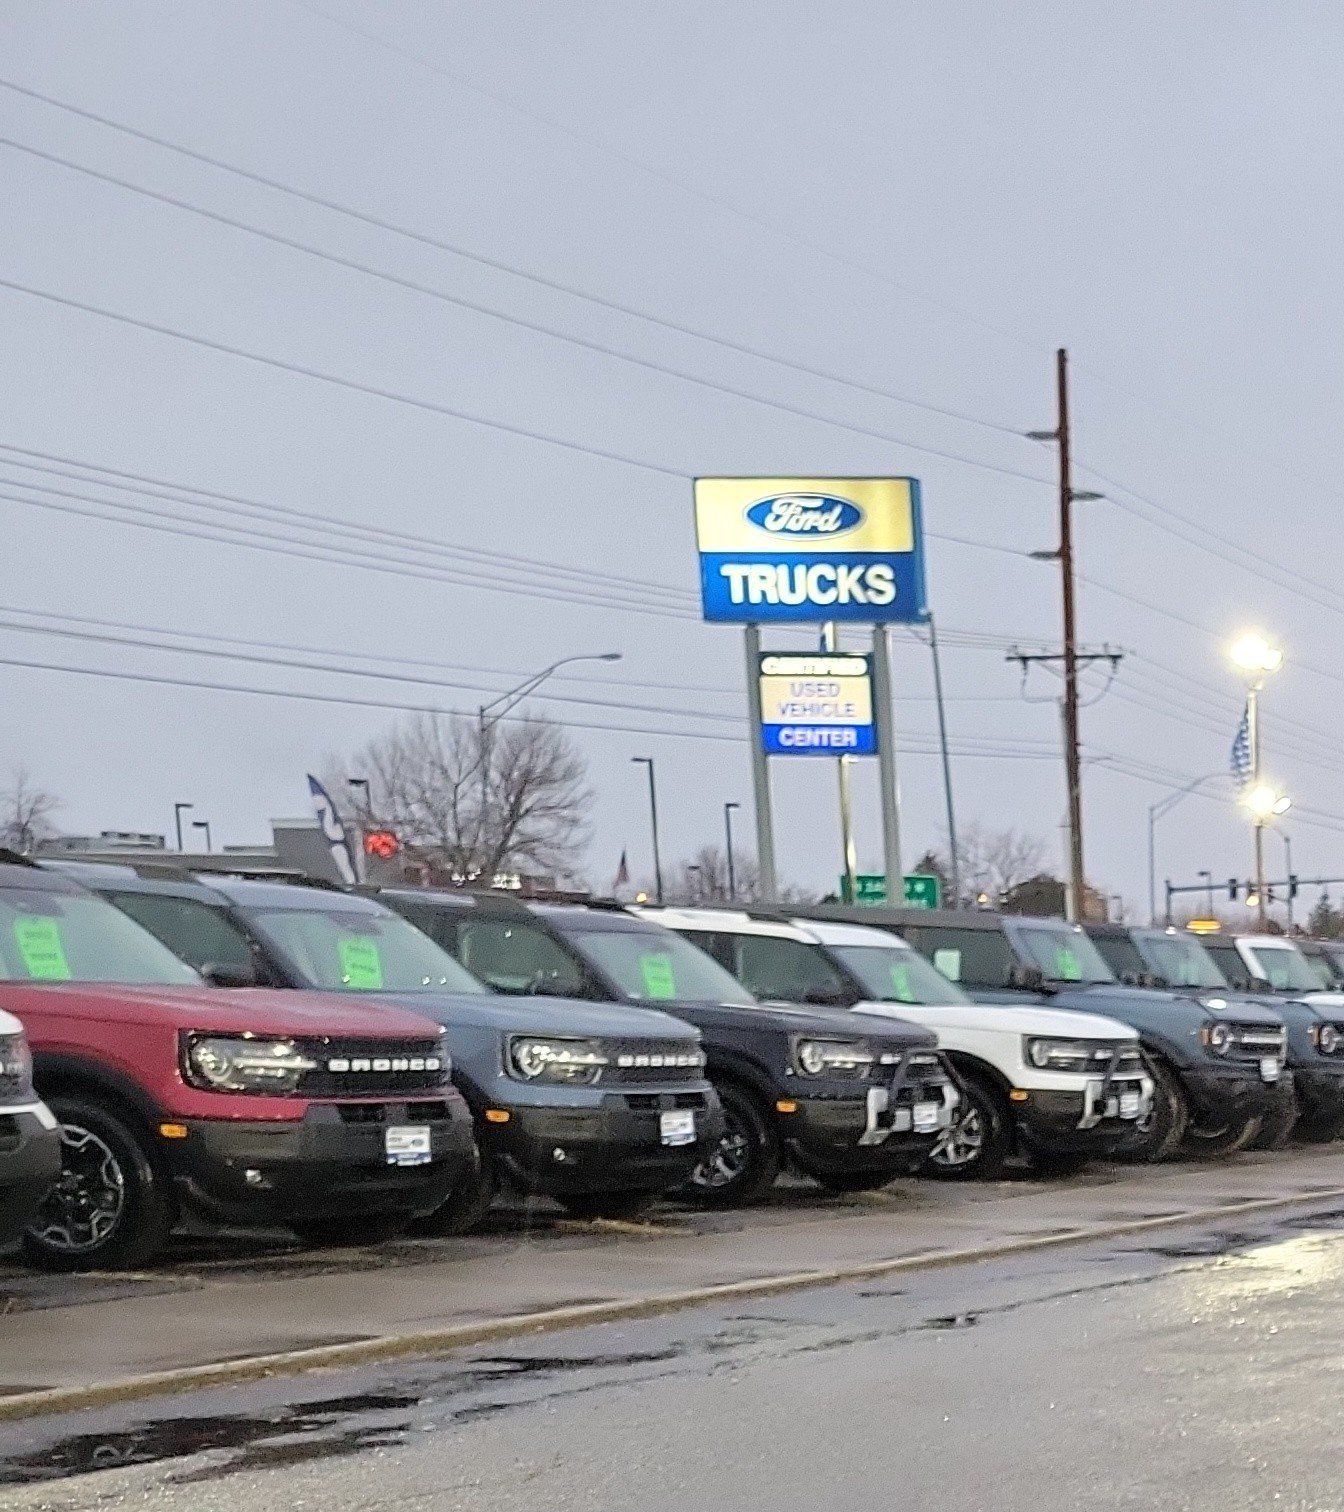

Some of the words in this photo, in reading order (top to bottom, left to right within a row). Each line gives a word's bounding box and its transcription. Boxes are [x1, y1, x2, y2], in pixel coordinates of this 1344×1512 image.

[764, 497, 843, 532] Ford
[720, 563, 897, 605] TRUCKS
[790, 683, 841, 697] USED
[778, 703, 857, 717] VEHICLE
[778, 727, 857, 747] CENTER
[328, 1058, 440, 1071] BRONCO
